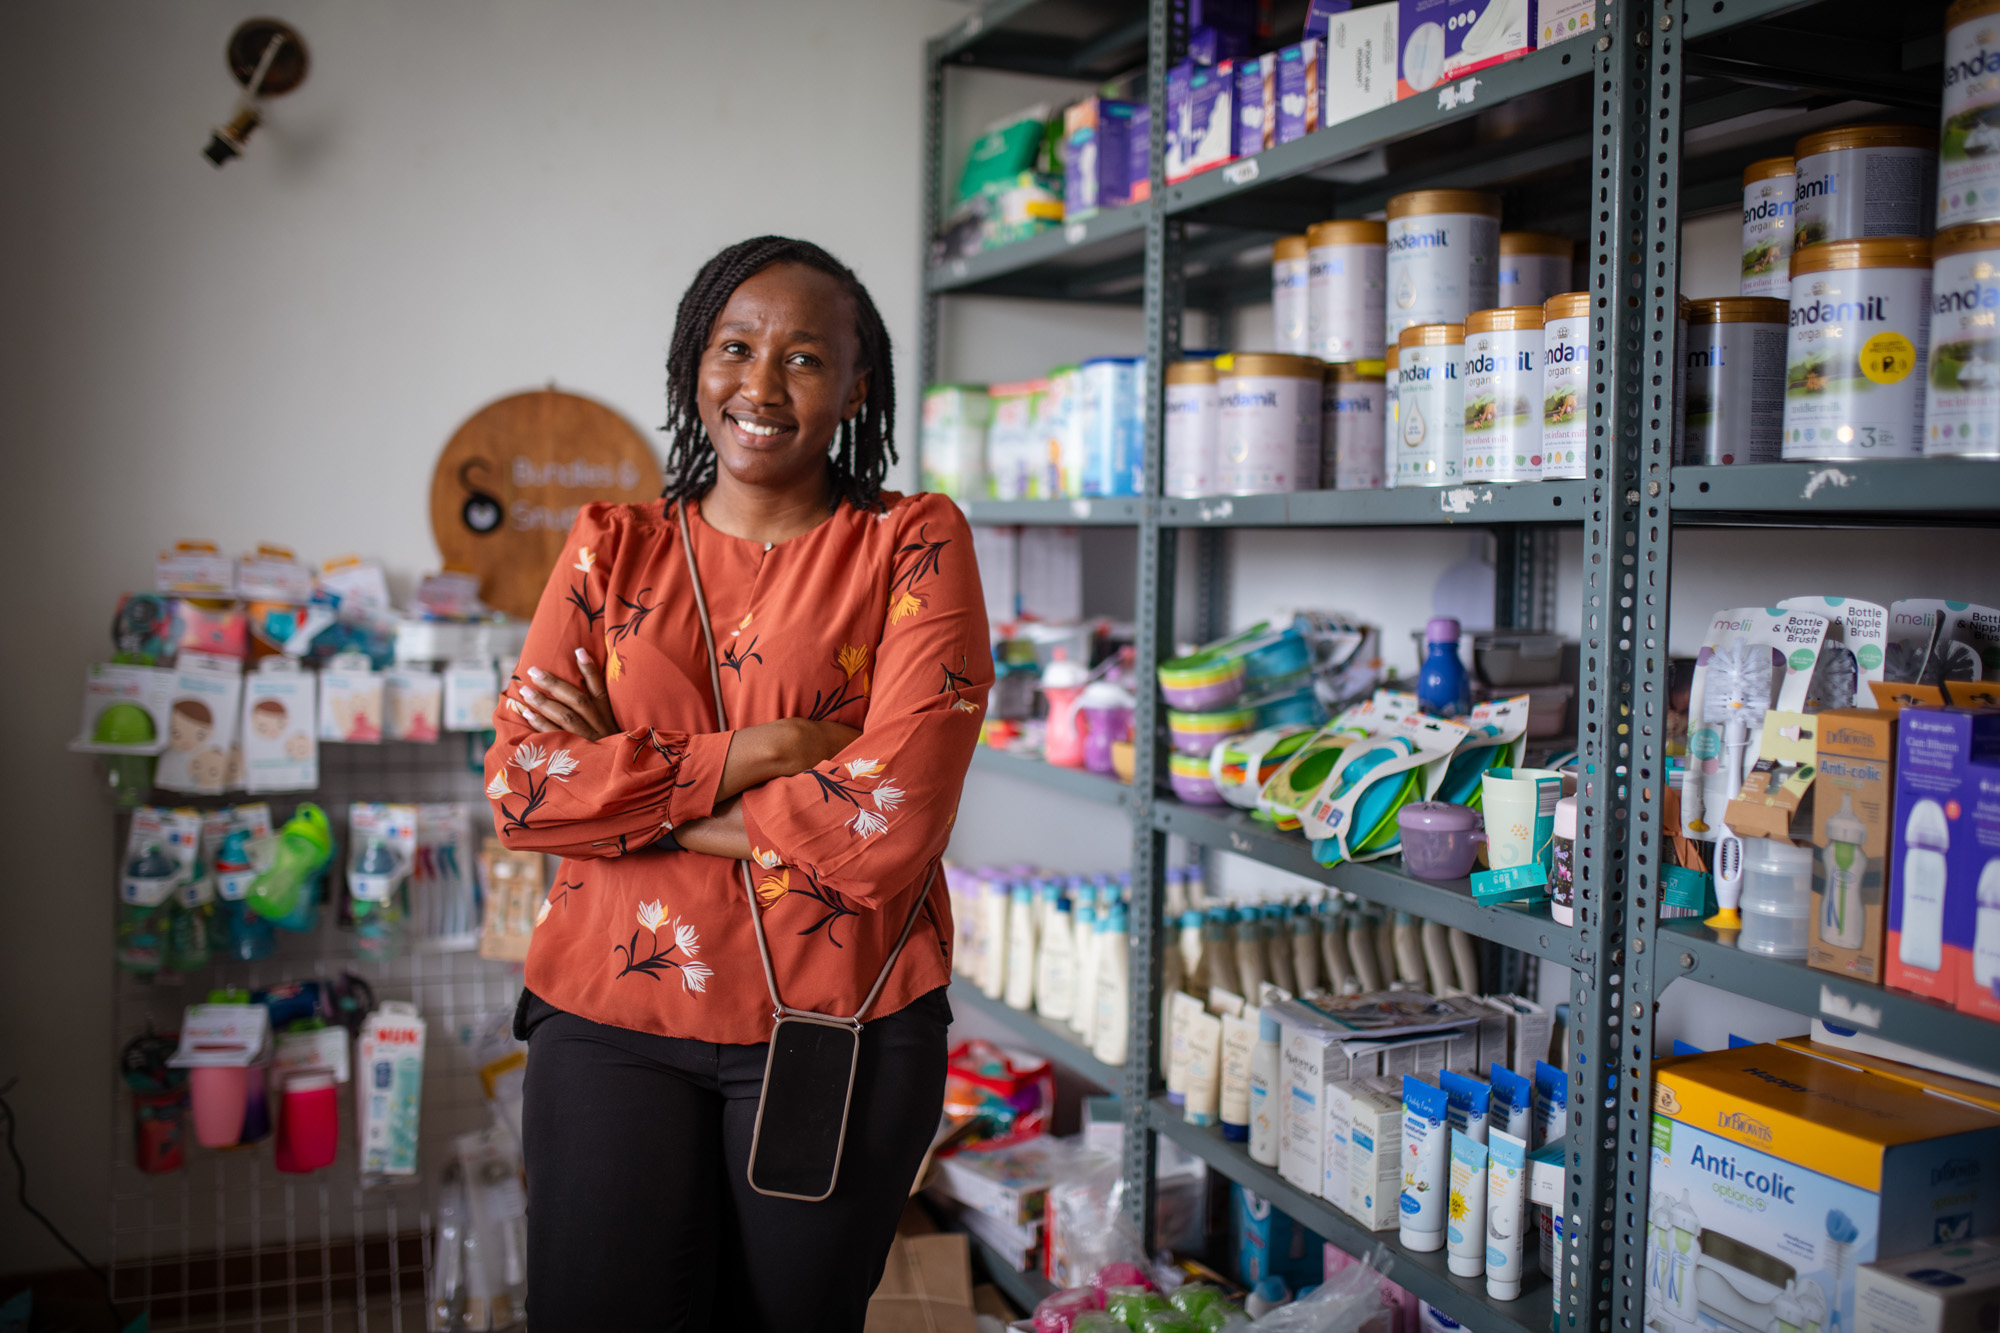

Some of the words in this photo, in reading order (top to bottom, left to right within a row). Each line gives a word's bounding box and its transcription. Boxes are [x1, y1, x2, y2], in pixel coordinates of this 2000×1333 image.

[1749, 218, 1785, 233] organic
[1797, 324, 1844, 342] organic
[1548, 365, 1582, 379] organic
[1469, 375, 1501, 388] organic
[1860, 426, 1877, 448] 3
[1444, 461, 1456, 477] 3
[1848, 606, 1882, 618] Bottle
[1714, 619, 1753, 632] melii
[1788, 616, 1823, 627] Bottle
[1834, 616, 1843, 625] &
[1846, 616, 1882, 629] Nipple
[1895, 612, 1935, 627] melii
[1957, 619, 1966, 629] &
[1772, 624, 1781, 633] &
[1784, 625, 1821, 636] Nipple
[1850, 627, 1881, 638] Brush
[1786, 634, 1818, 644] Brush
[1821, 759, 1882, 781] Anti-colic
[375, 1027, 418, 1045] NUK
[1690, 1144, 1796, 1205] Anti-colic
[1711, 1182, 1755, 1208] options
